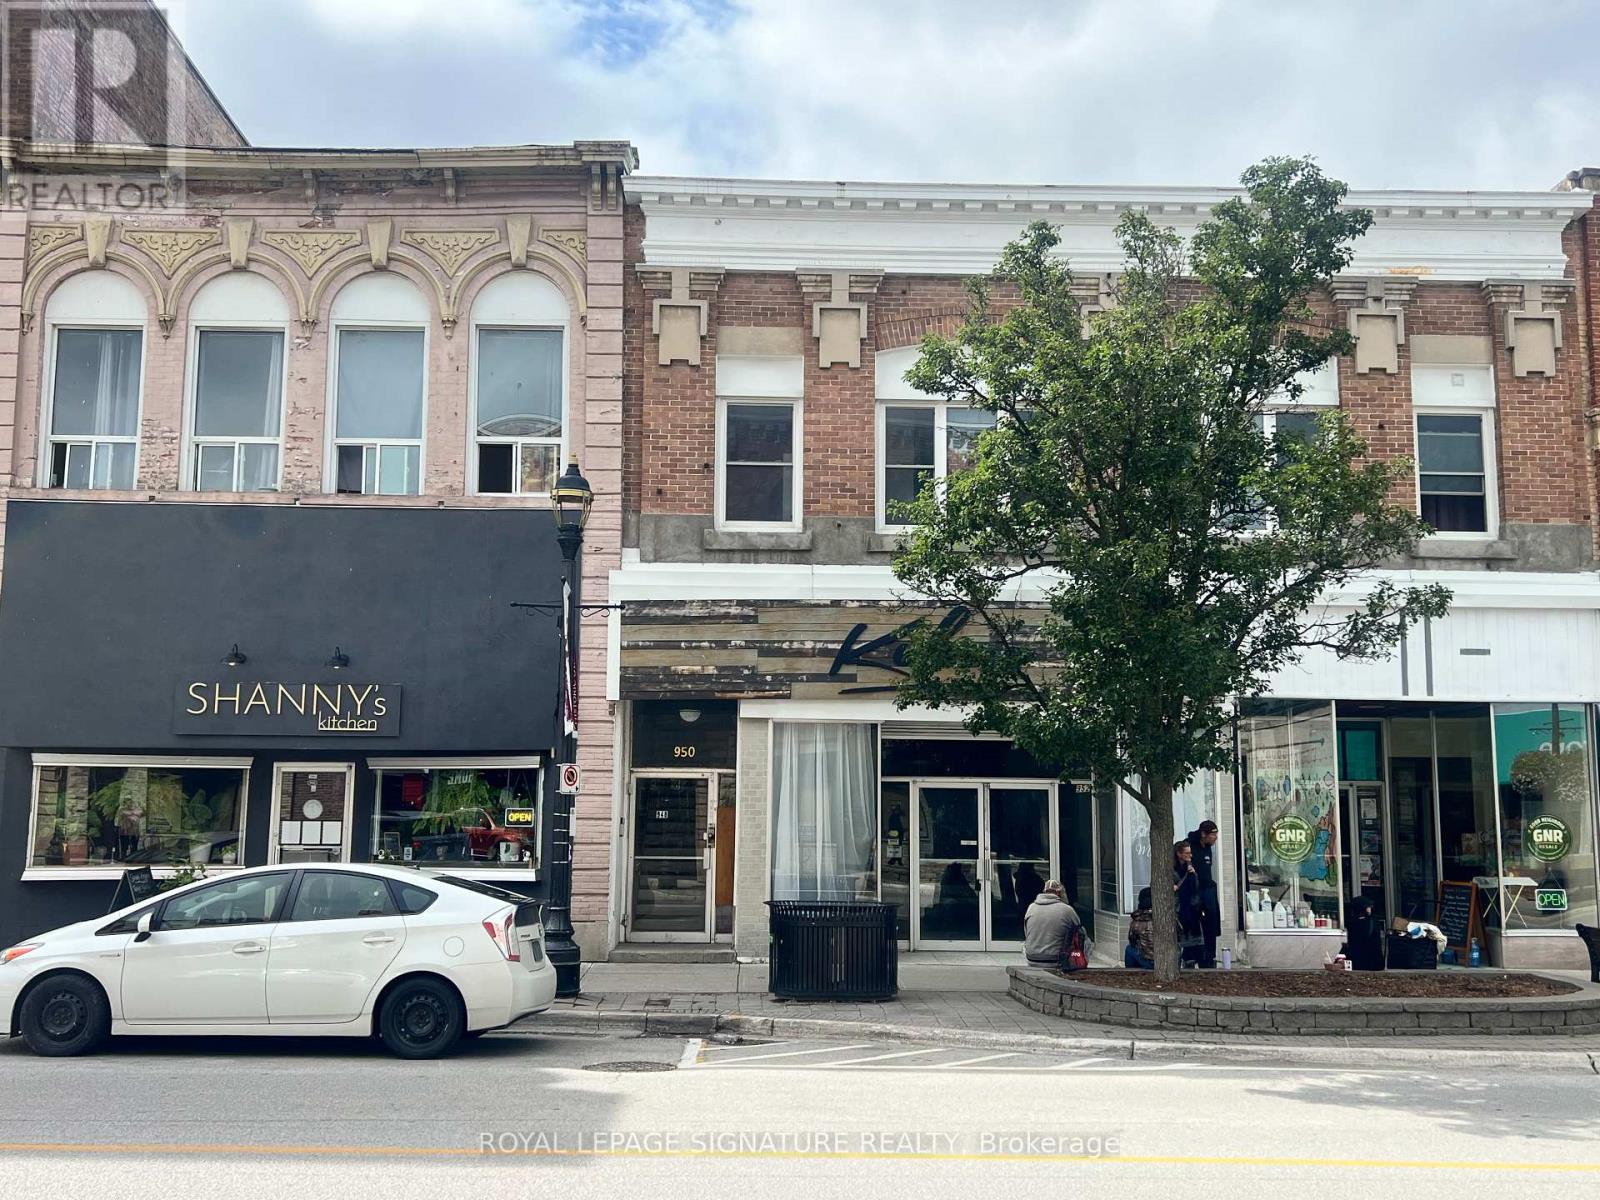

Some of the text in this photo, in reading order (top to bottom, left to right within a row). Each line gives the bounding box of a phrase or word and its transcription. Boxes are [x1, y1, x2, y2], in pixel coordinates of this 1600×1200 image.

[186, 681, 387, 716] SHANNY's
[317, 711, 378, 731] kitchen
[673, 746, 696, 758] 950
[508, 812, 532, 822] OPEN
[1275, 829, 1307, 842] GNR
[1532, 829, 1564, 843] GNR
[1538, 893, 1566, 906] OPEN
